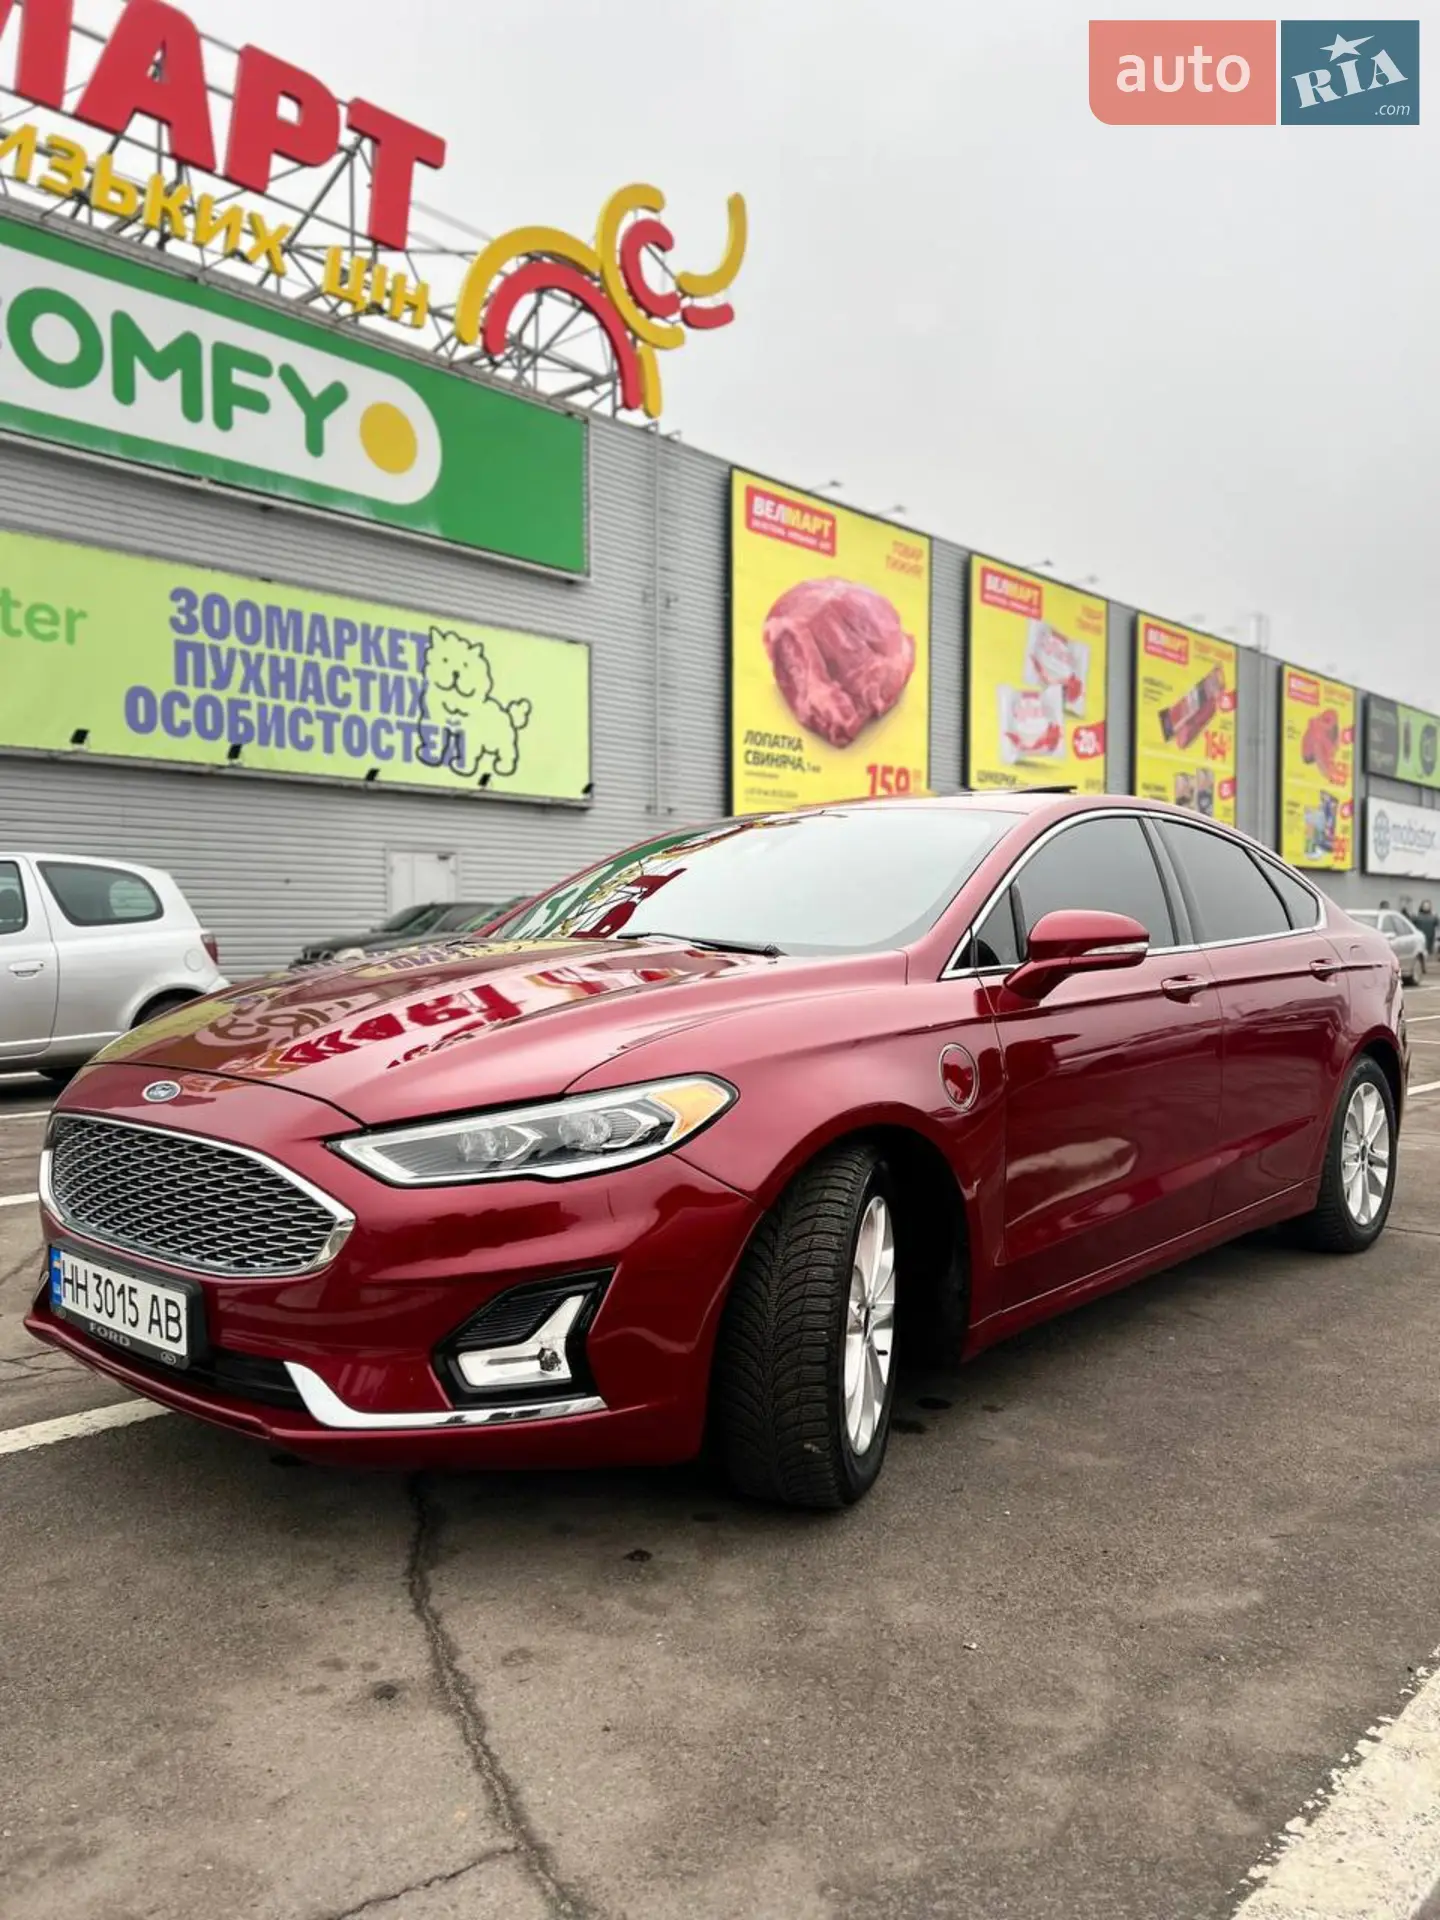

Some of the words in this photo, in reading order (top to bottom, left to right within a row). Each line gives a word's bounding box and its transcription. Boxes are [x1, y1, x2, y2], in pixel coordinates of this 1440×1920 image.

[321, 244, 430, 329] ЦІН
[0, 286, 348, 458] OMFY
[0, 587, 88, 646] ter
[168, 587, 430, 674] ЗООМАРКЕТ
[173, 638, 431, 721] ПУХНАСТИХ
[124, 686, 466, 769] ОСОБИСТОСТЕЙ
[743, 730, 804, 752] ЛОПАТКА
[62, 1260, 89, 1309] HH
[92, 1273, 139, 1328] 3015
[148, 1294, 183, 1344] AB
